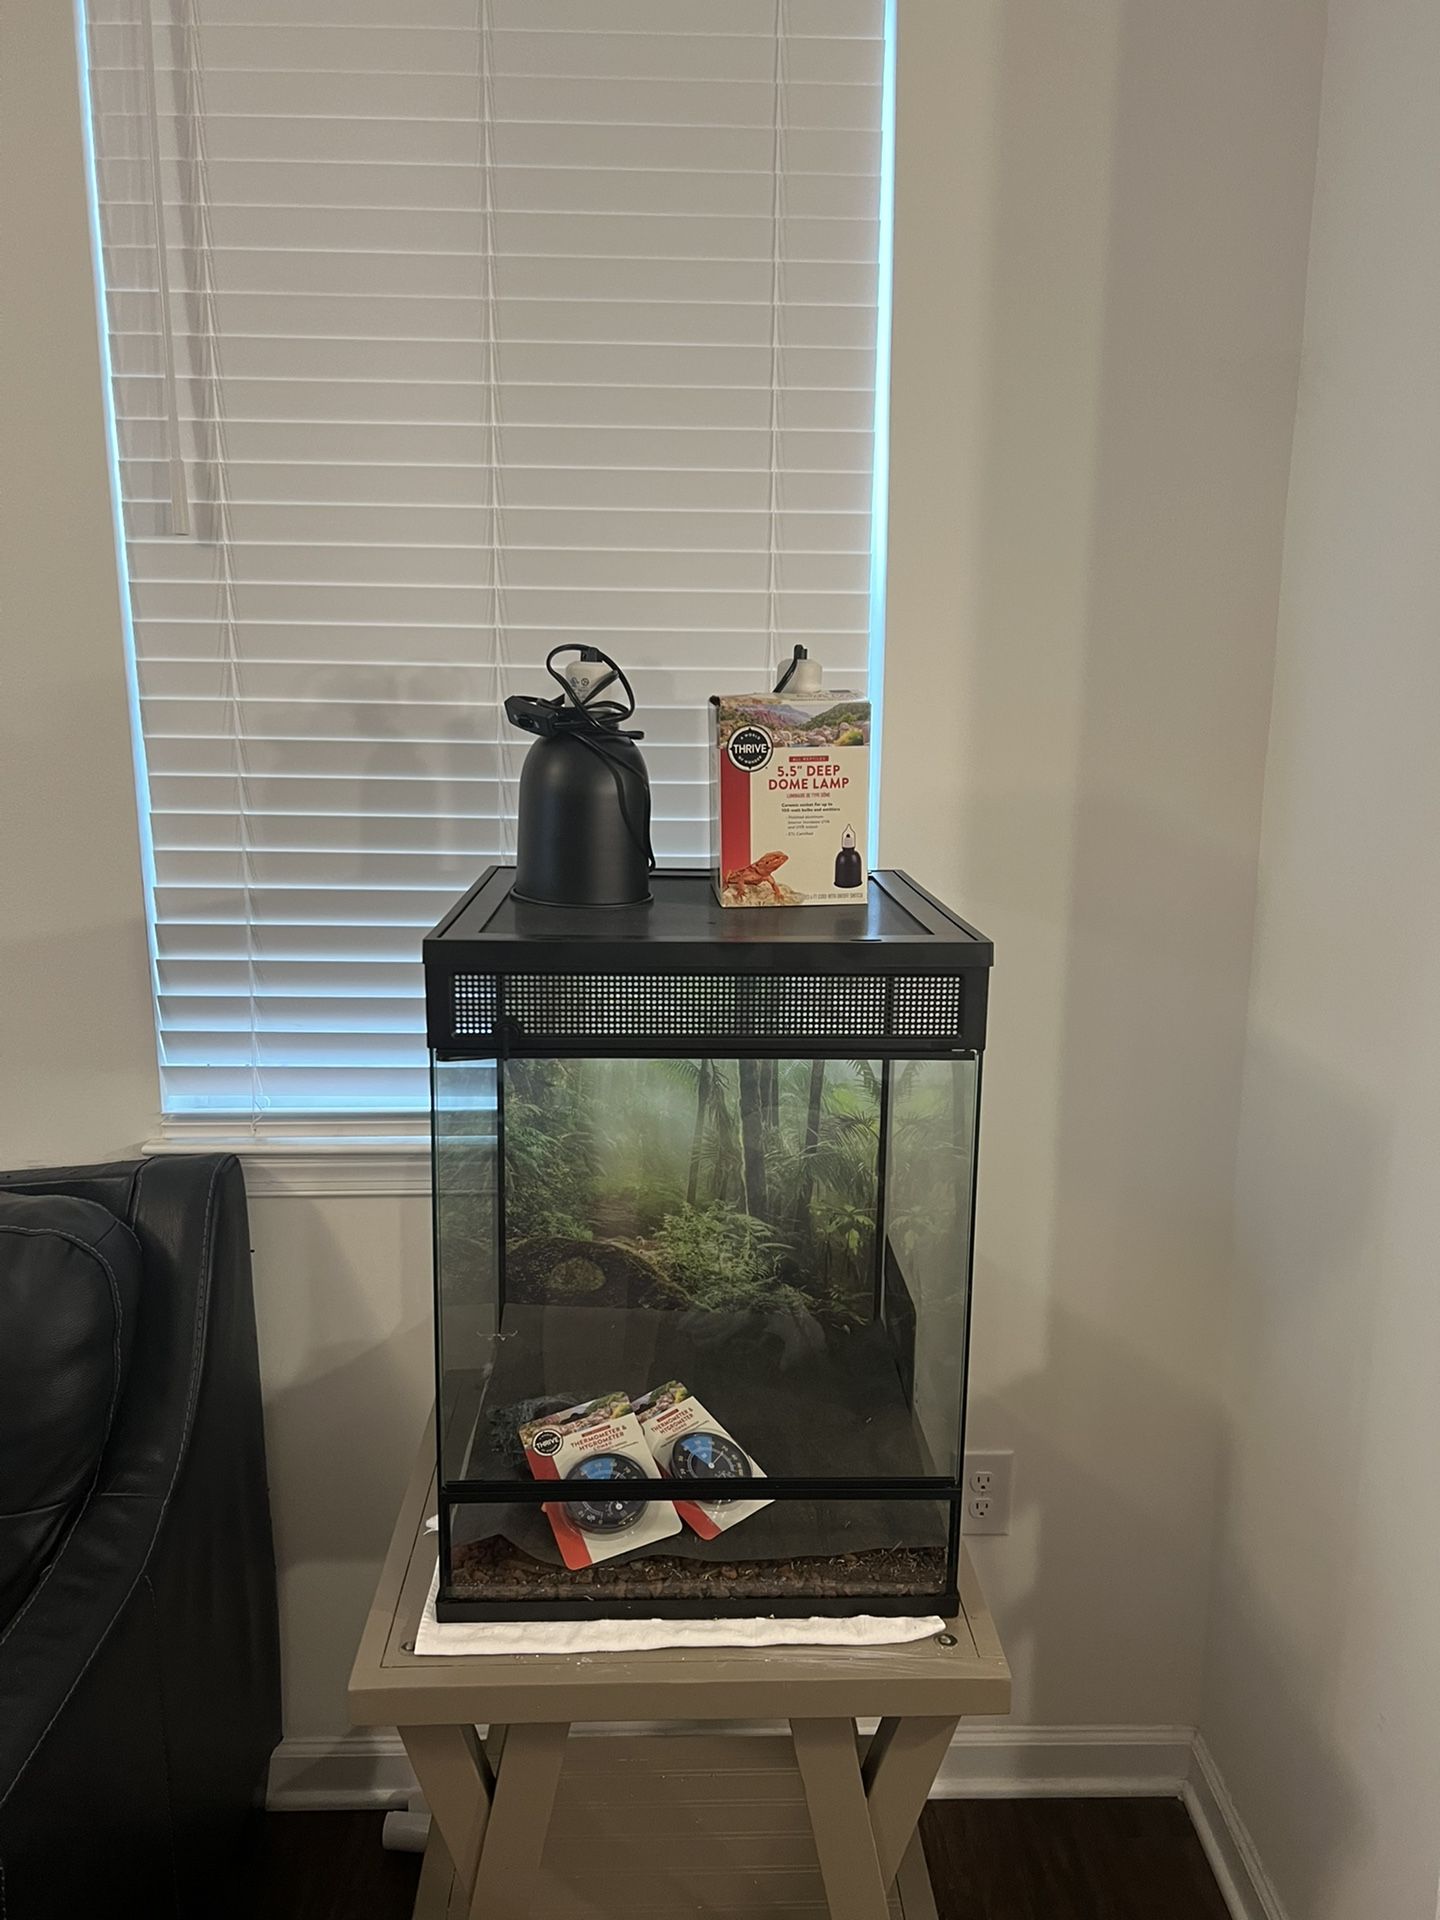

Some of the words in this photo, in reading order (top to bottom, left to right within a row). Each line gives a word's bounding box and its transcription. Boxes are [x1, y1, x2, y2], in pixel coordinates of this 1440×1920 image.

[733, 743, 767, 754] THRIVE
[777, 765, 802, 777] 5.5"
[807, 764, 840, 776] DEEP
[768, 778, 808, 790] DOME
[813, 777, 849, 789] LAMP
[651, 1409, 690, 1432] THERMOMETER
[659, 1413, 694, 1434] HYGROMETER
[536, 1435, 560, 1449] THRIVE
[570, 1428, 622, 1448] THERMOMETER
[578, 1432, 625, 1451] HYGROMETER
